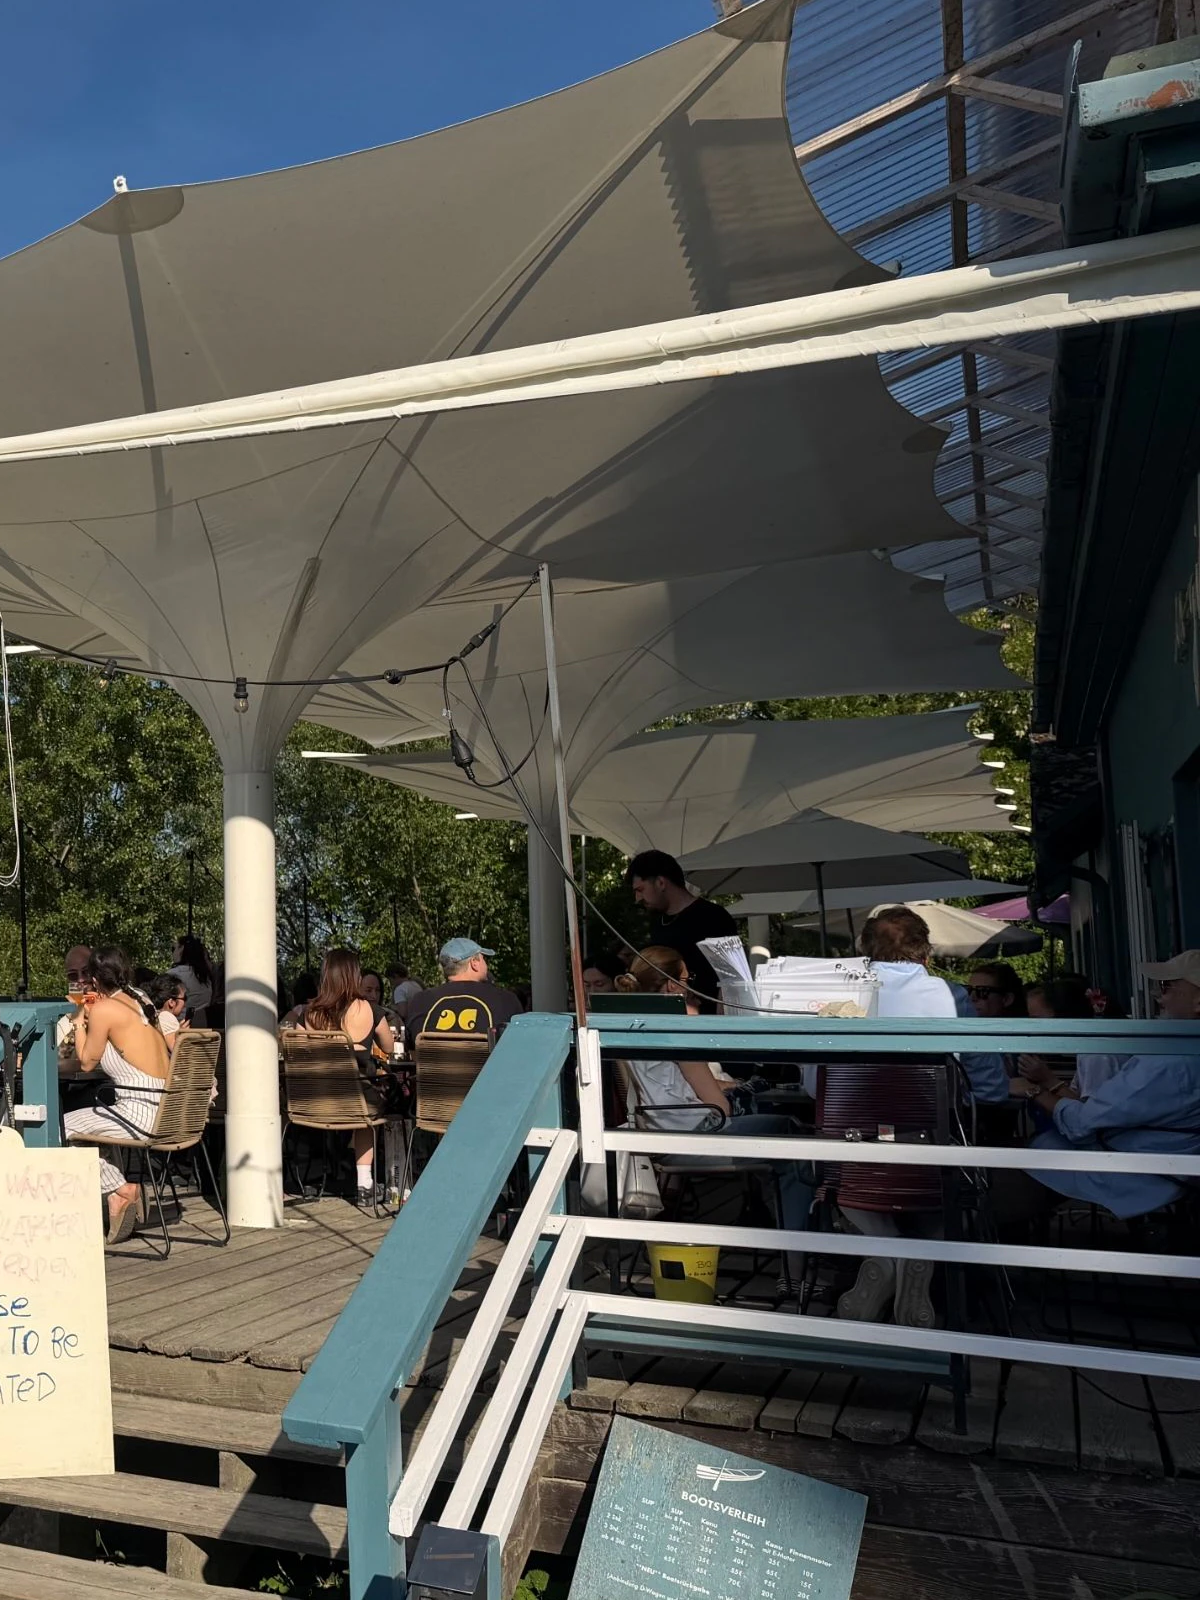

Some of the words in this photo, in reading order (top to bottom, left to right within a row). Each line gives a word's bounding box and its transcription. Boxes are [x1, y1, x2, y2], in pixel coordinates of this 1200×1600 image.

[8, 1326, 40, 1356] TO
[670, 1507, 683, 1516] SUP
[681, 1490, 766, 1528] BOOTSVERLEIH
[701, 1517, 718, 1529] Kanu
[732, 1528, 751, 1540] Kanu
[765, 1539, 783, 1551] Kanu
